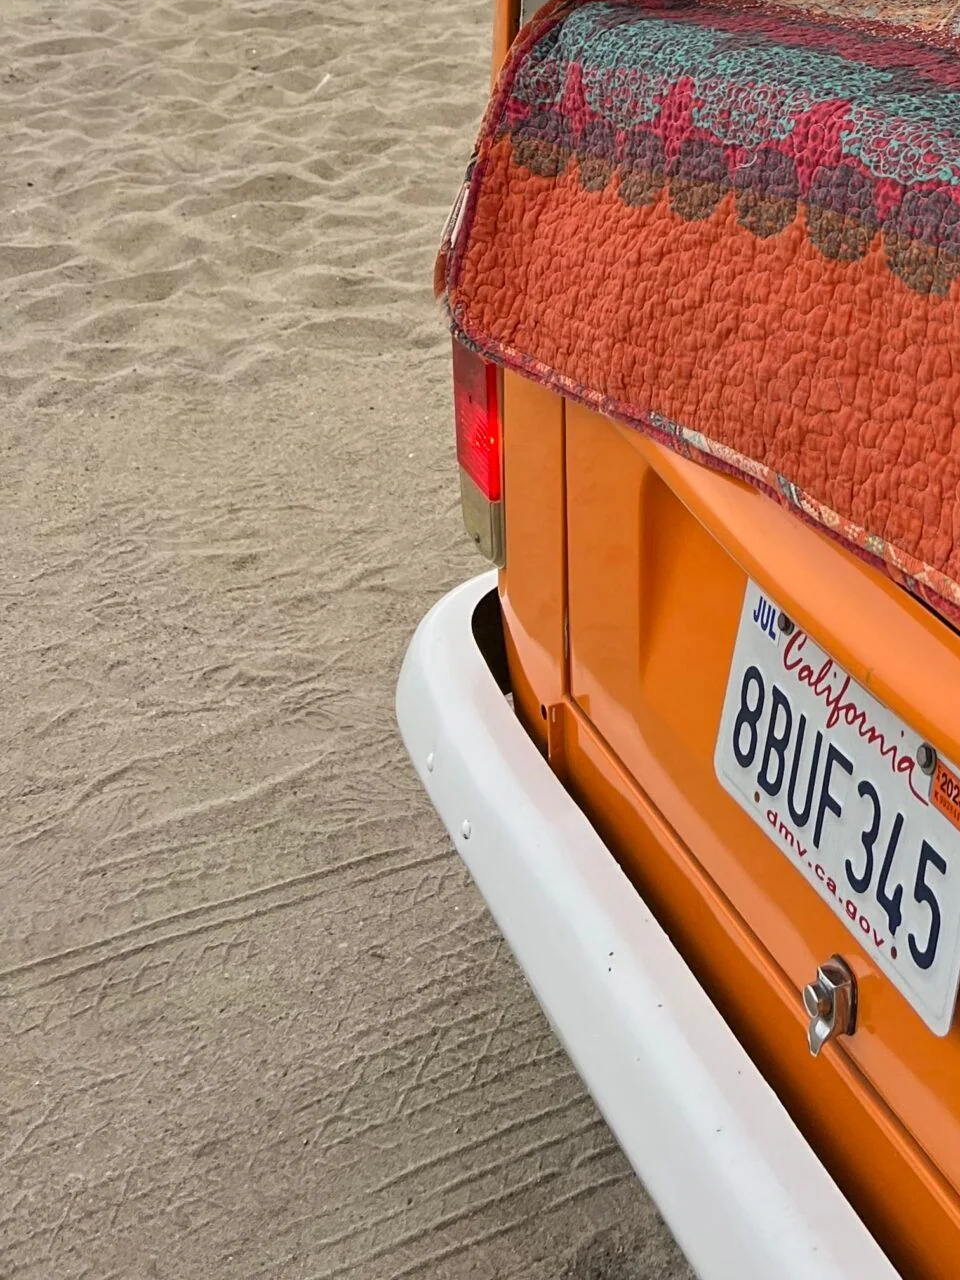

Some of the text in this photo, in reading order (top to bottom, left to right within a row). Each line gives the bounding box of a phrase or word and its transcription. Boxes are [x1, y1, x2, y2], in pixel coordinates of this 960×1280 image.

[753, 595, 776, 641] JUL
[783, 629, 929, 807] California
[732, 665, 947, 970] 8BUF345
[766, 809, 885, 948] dmv.ca.gov
